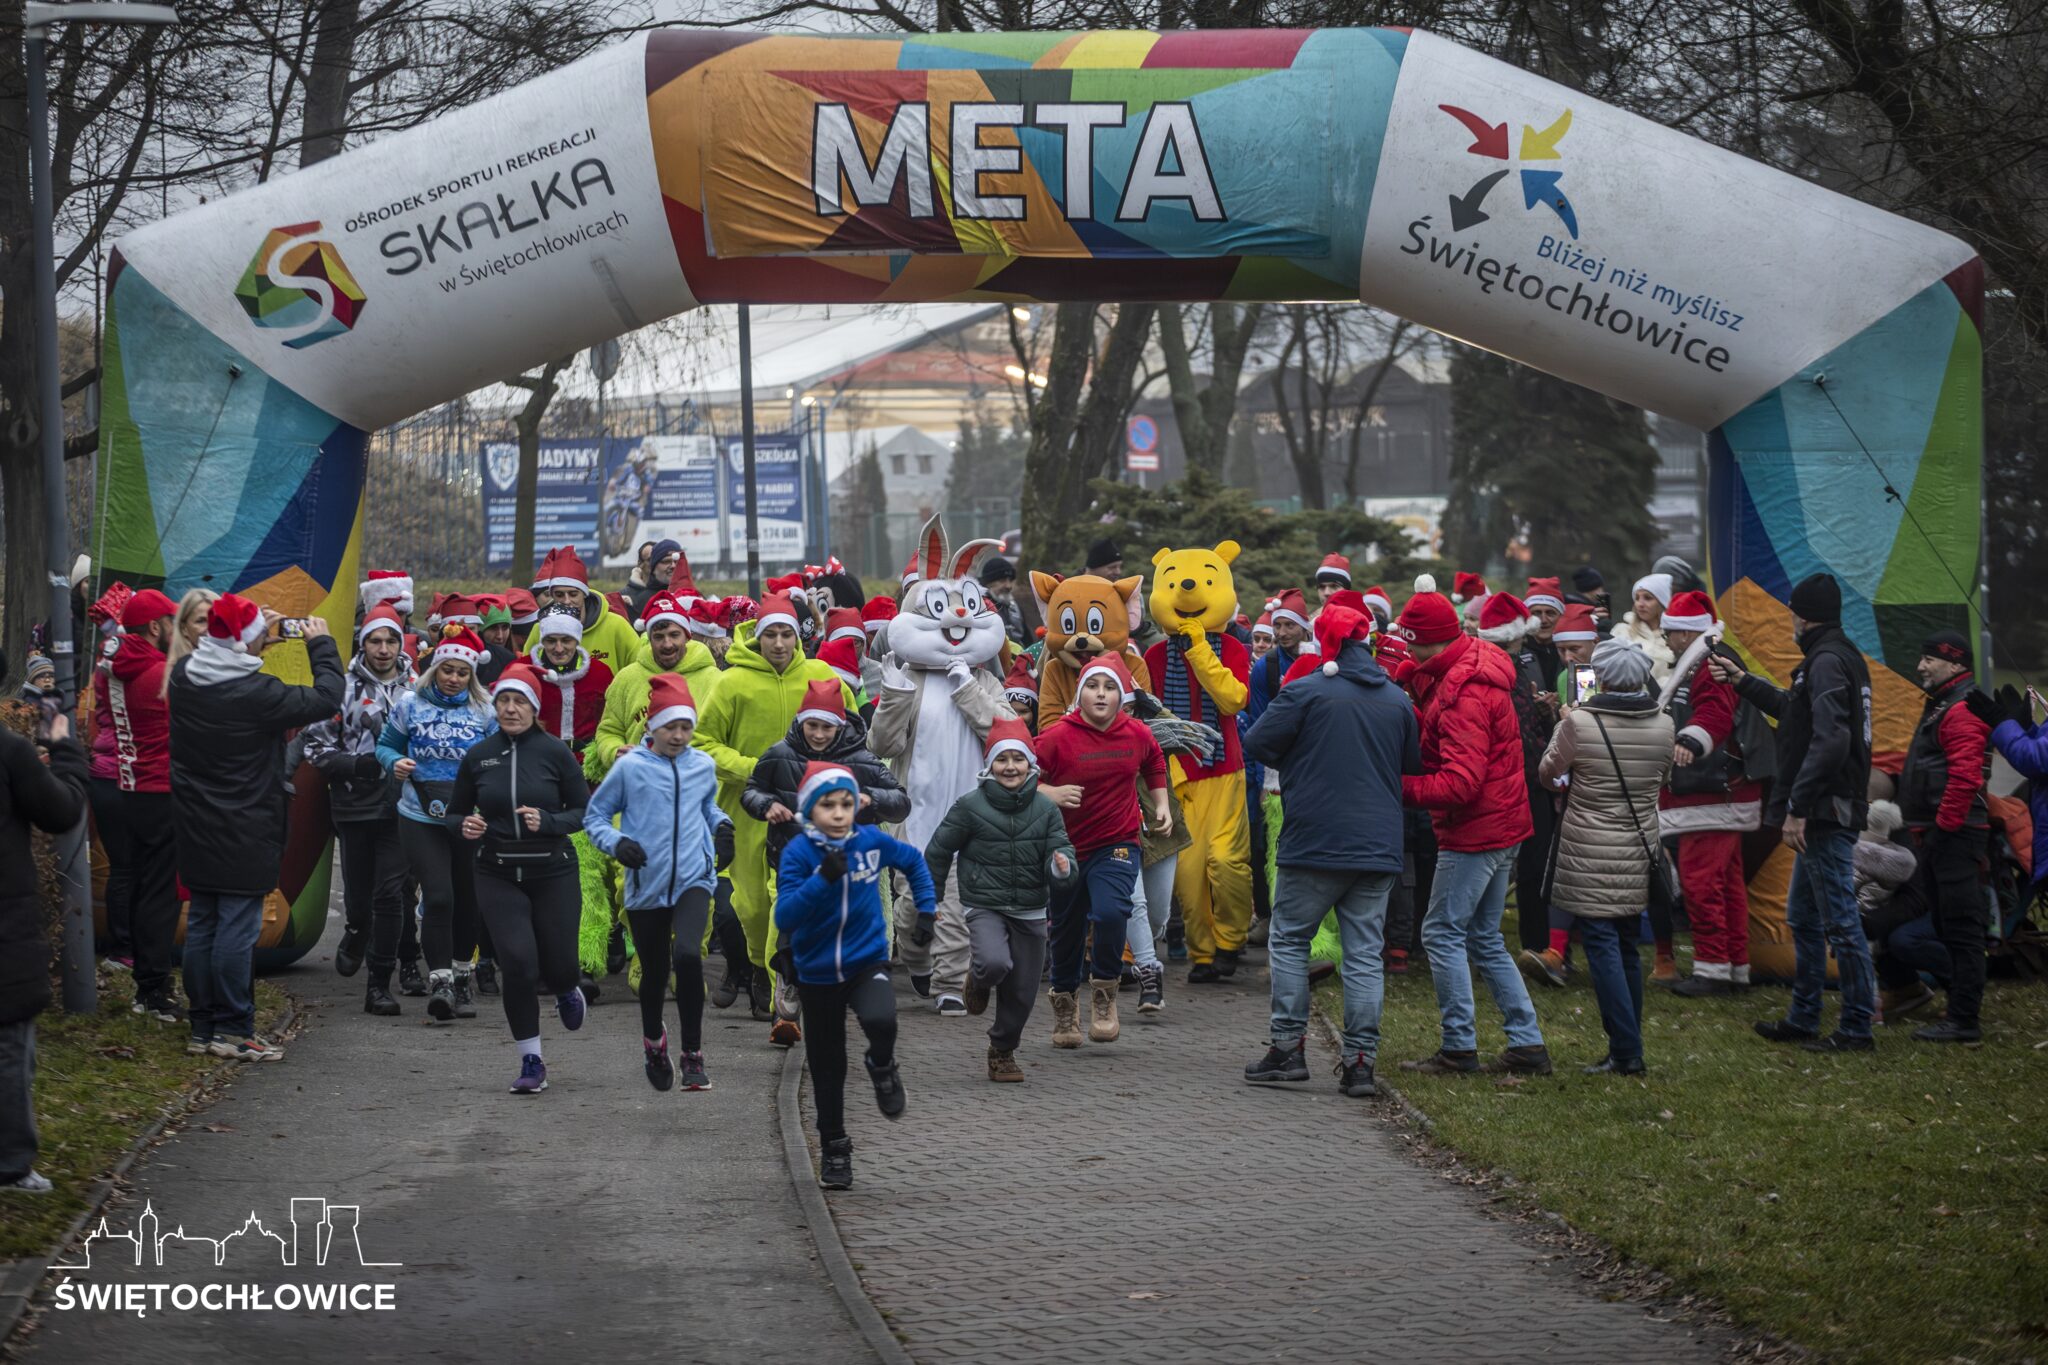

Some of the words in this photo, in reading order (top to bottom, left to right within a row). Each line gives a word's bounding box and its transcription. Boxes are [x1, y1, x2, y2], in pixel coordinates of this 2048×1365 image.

[344, 193, 425, 233] OŚRODEK
[427, 166, 494, 202] SPORTU
[496, 161, 503, 177] I
[505, 127, 597, 174] REKREACJI
[379, 157, 616, 276] SKAŁKA
[811, 101, 1229, 223] META
[438, 277, 458, 293] w
[459, 209, 630, 287] Świętochłowicach
[1400, 215, 1731, 374] Świętochłowice
[1536, 234, 1607, 283] Bliżej
[1609, 267, 1648, 296] niż
[1651, 283, 1745, 332] myślisz
